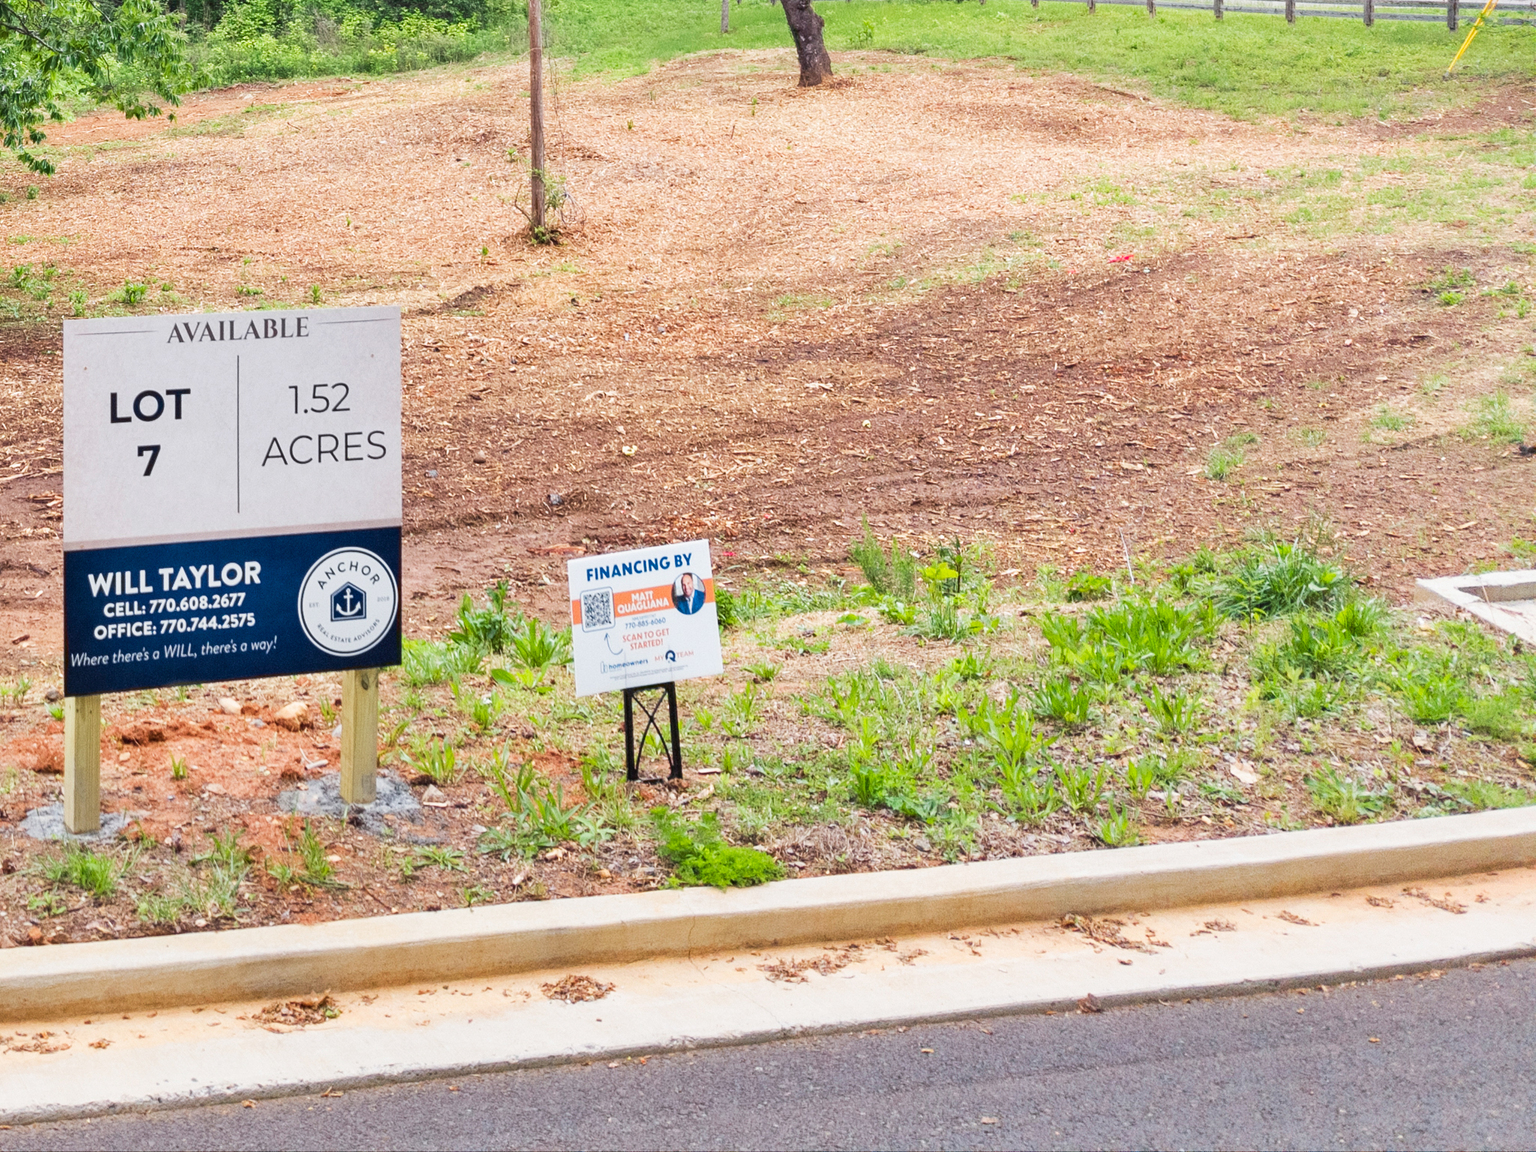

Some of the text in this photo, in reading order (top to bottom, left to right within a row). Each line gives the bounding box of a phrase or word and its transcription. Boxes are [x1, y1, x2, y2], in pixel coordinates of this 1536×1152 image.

[167, 316, 310, 344] AVAILABLE
[110, 388, 191, 424] LOT
[288, 382, 351, 415] 1.52
[137, 444, 162, 477] 7
[261, 430, 388, 468] ACRES
[87, 560, 262, 598] WILL TAYLOR
[317, 560, 381, 590] ANCHOR
[586, 553, 692, 582] FINANCING BY
[103, 592, 246, 618] CELL: 770.608.2677
[617, 597, 670, 614] QUAGLIANA
[631, 590, 654, 603] MATT
[93, 612, 256, 640] OFFICE: 770.744.2575
[317, 618, 381, 643] REAL ESTATE ADVISORS
[622, 628, 670, 643] SCAN TO GET
[70, 635, 278, 668] Where there's a WILL, there's a way!
[630, 638, 664, 651] STARTED!
[676, 650, 695, 659] TEAM
[608, 658, 649, 670] homeowners
